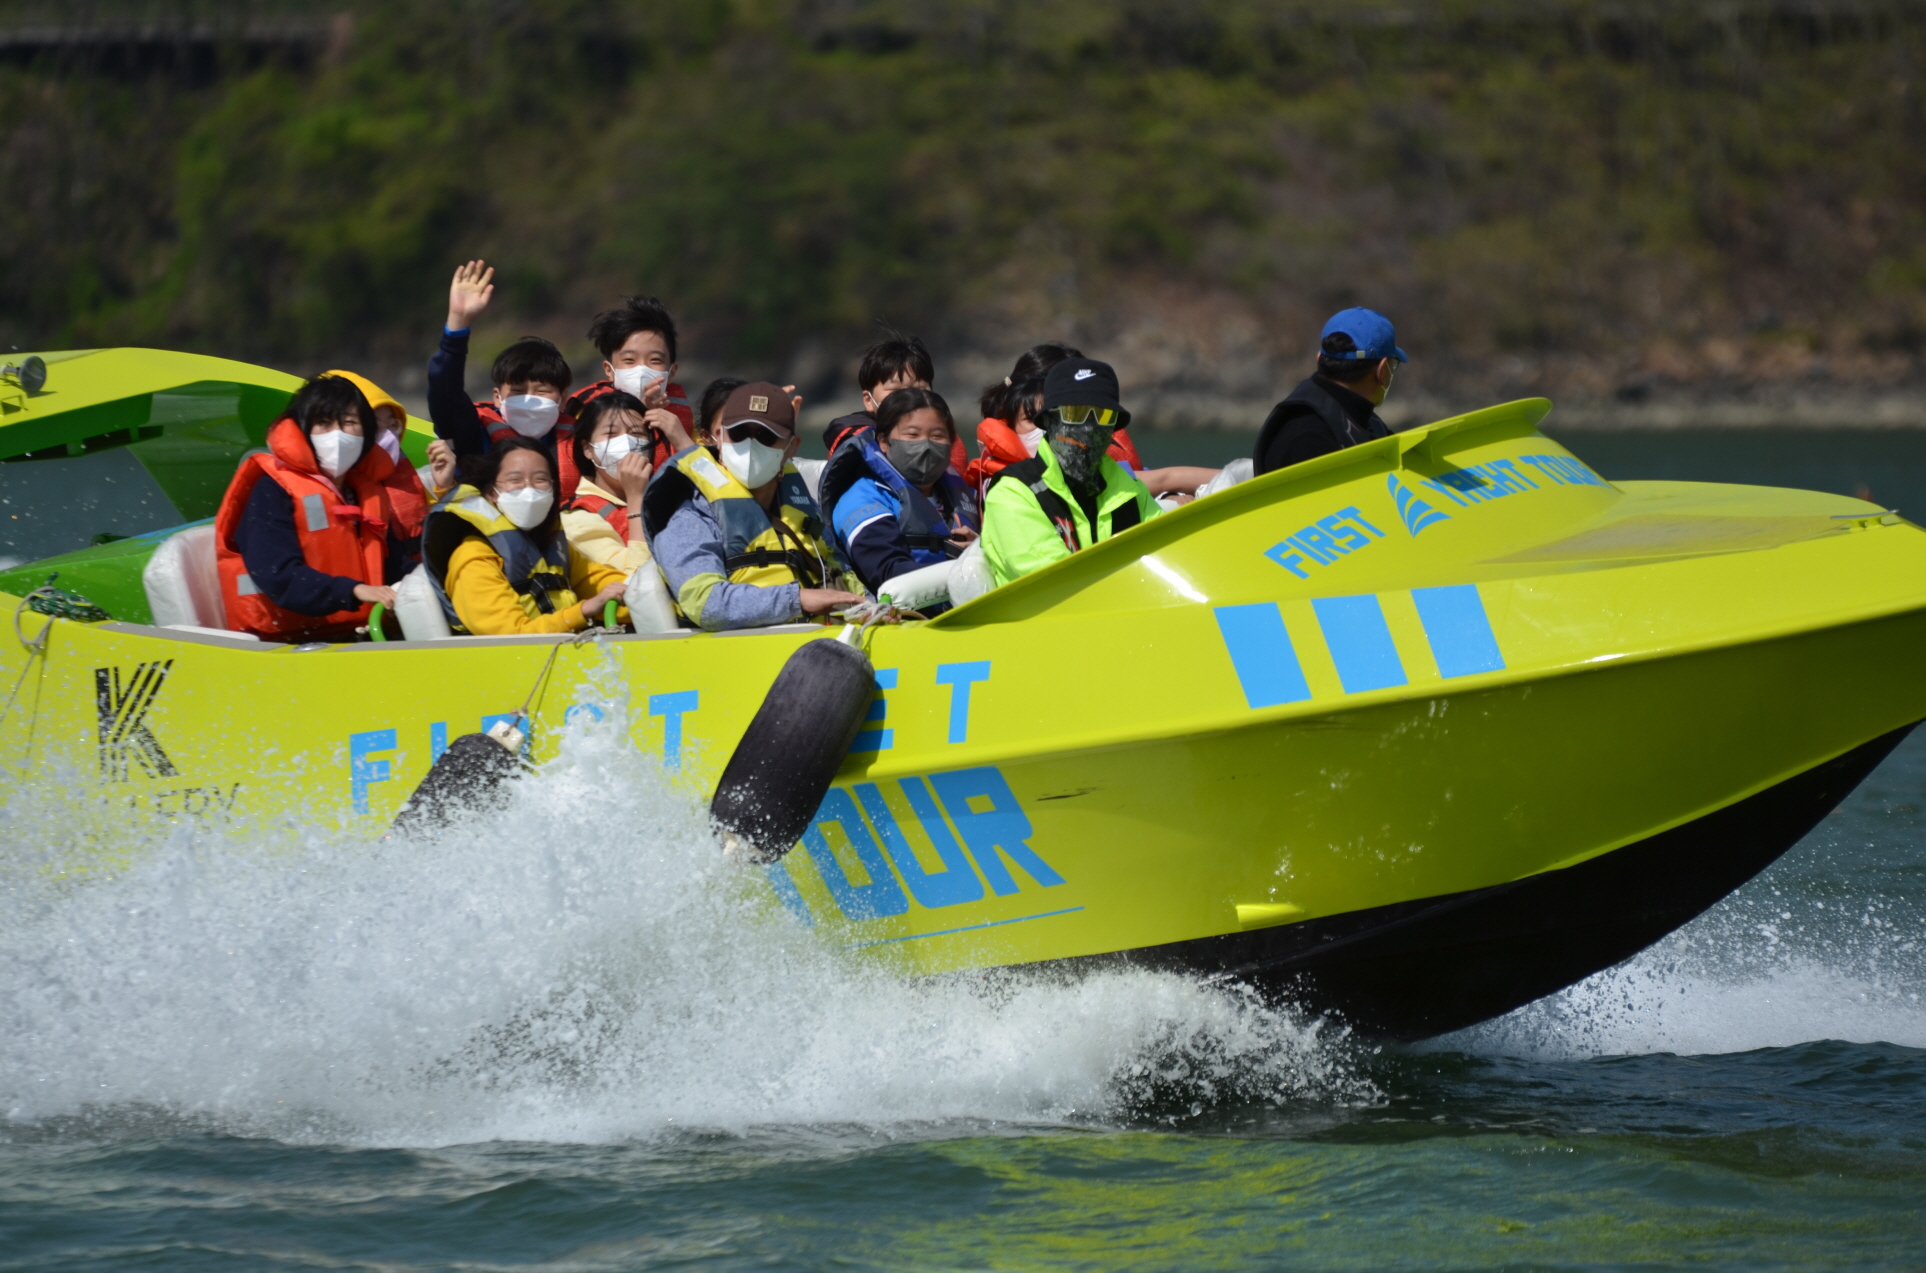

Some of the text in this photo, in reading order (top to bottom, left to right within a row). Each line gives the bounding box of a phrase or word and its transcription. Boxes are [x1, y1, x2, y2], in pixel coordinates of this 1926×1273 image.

[1262, 505, 1386, 580] FIRST
[1420, 458, 1542, 508] YACHT
[850, 660, 992, 753] ET
